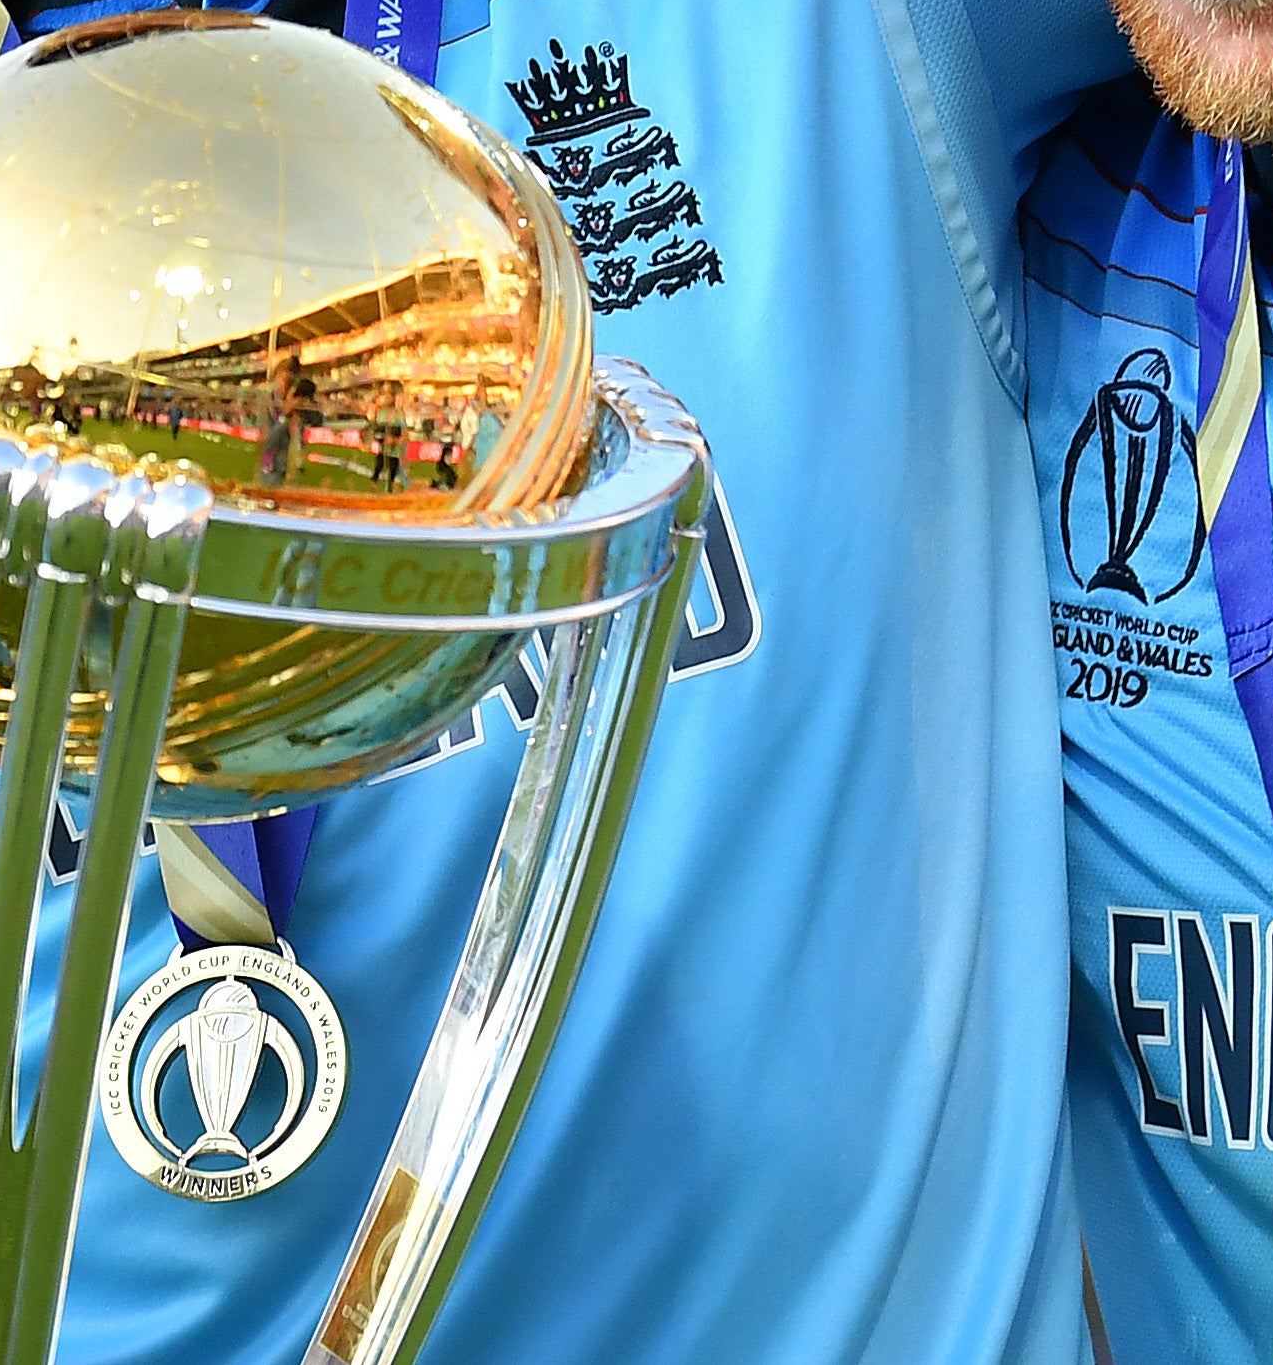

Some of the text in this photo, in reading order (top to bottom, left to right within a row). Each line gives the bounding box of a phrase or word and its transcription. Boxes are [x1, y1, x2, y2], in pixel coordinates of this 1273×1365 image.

[1114, 611, 1166, 638] WORLD
[1167, 624, 1199, 646] CUP
[1052, 624, 1213, 678] GLAND & WALES
[1065, 657, 1149, 708] 2019
[198, 954, 230, 971] CUP
[241, 954, 311, 999] ENGLAND
[108, 1010, 139, 1083] CRICKET
[317, 1012, 338, 1070] WALES
[108, 1089, 123, 1116] ICC
[317, 1077, 336, 1114] 2019
[158, 1164, 273, 1197] WINNERS
